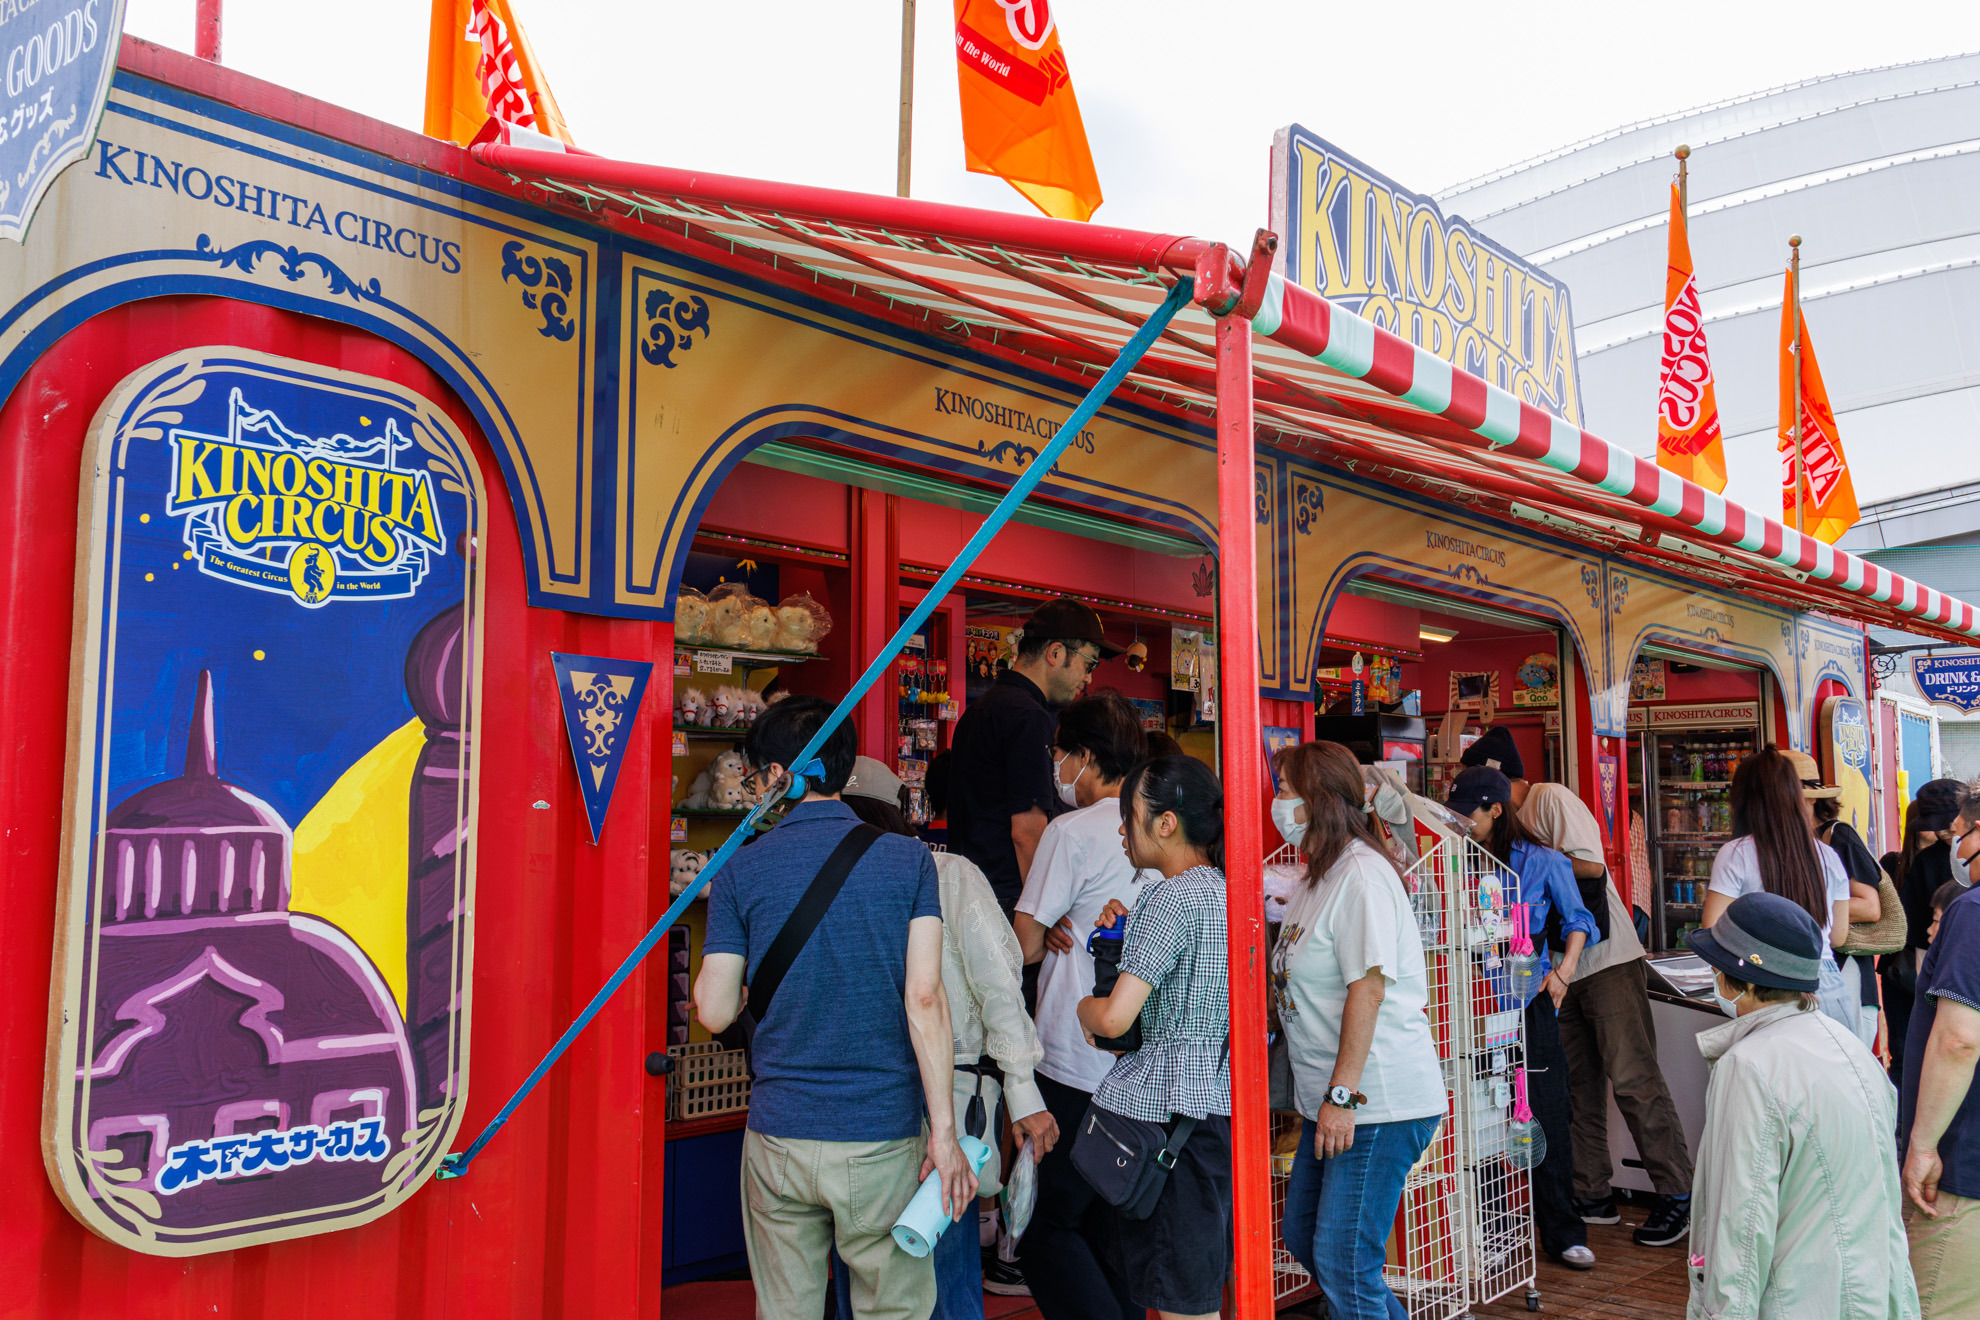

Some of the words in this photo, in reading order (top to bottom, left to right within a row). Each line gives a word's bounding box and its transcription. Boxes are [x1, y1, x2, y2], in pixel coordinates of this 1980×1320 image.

[6, 0, 98, 98] GOODS
[963, 40, 980, 59] the
[980, 51, 1011, 77] World
[95, 139, 461, 274] KINOSHITACIRCUS
[1297, 142, 1582, 429] KINOSHITA
[175, 437, 440, 543] KINOSHITA
[226, 493, 397, 563] CIRCUS
[1426, 530, 1505, 567] KINOSHITACIRCUS
[209, 554, 225, 567] The
[226, 561, 260, 578] Greatest
[262, 571, 288, 583] Circus
[336, 581, 345, 590] in
[346, 581, 358, 590] the
[359, 581, 381, 590] World
[1925, 671, 1969, 685] DRINK
[1353, 682, 1363, 713] ミネラル
[1529, 694, 1548, 702] Qoo
[1653, 708, 1752, 721] KINOSHITACIRCUS
[160, 1120, 387, 1190] 木下大サーカス
